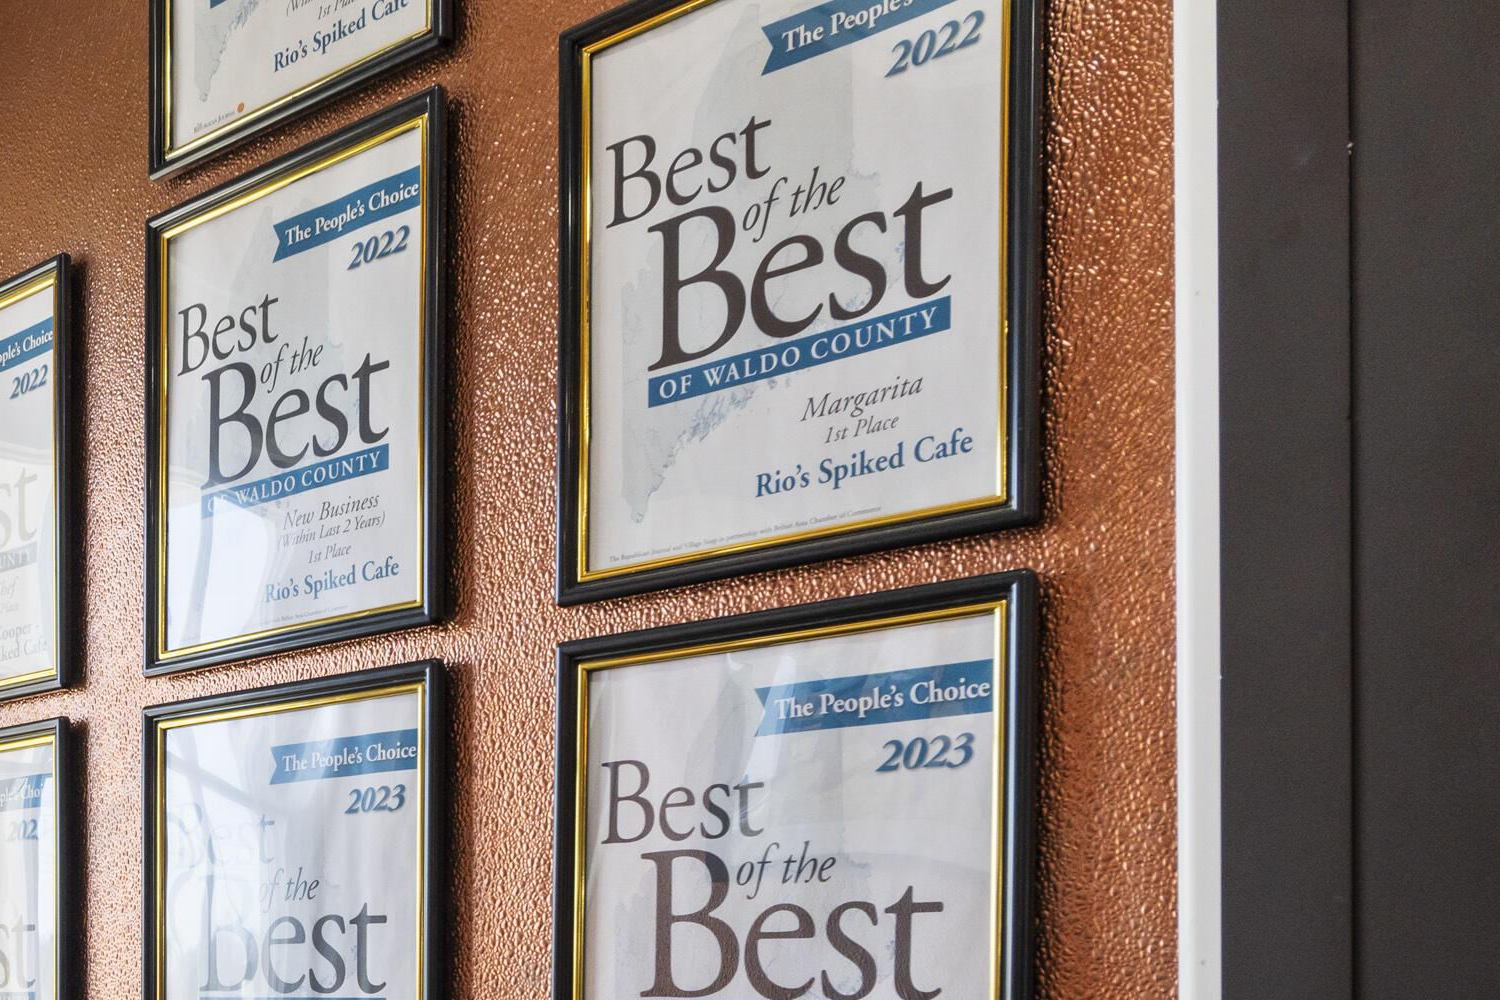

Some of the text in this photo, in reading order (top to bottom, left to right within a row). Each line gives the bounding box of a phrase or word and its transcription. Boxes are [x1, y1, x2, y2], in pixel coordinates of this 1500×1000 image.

[274, 39, 308, 72] Rio's
[312, 7, 366, 55] Spiked
[781, 24, 824, 54] The
[884, 10, 986, 78] 2022
[605, 115, 772, 229] Best
[285, 182, 419, 247] The People's Choice
[743, 166, 846, 242] of the
[347, 225, 410, 271] 2022
[647, 181, 954, 372] Best
[23, 330, 53, 352] Choice
[177, 293, 279, 377] Best
[659, 306, 938, 399] OF WALDO COUNTY
[10, 364, 49, 399] 2022
[260, 336, 324, 394] of the
[201, 353, 389, 490] Best
[799, 376, 924, 421] Margarita
[824, 413, 900, 444] 1st Place
[235, 475, 296, 505] WALDO
[301, 451, 381, 486] COUNTY
[755, 427, 973, 499] Rio's Spiked Cafe
[283, 494, 380, 530] New Business
[319, 521, 342, 540] Last
[342, 518, 352, 534] 2
[354, 511, 385, 532] Years)
[308, 543, 352, 565] 1st Place
[265, 555, 399, 603] Rio's Spiked Cafe
[775, 678, 991, 720] The People's Choice
[282, 741, 417, 772] The People's Choice
[875, 732, 975, 774] 2023
[345, 784, 406, 815] 2023
[601, 759, 765, 846] Best
[8, 819, 38, 841] 202
[285, 866, 319, 901] the
[736, 839, 837, 900] of the
